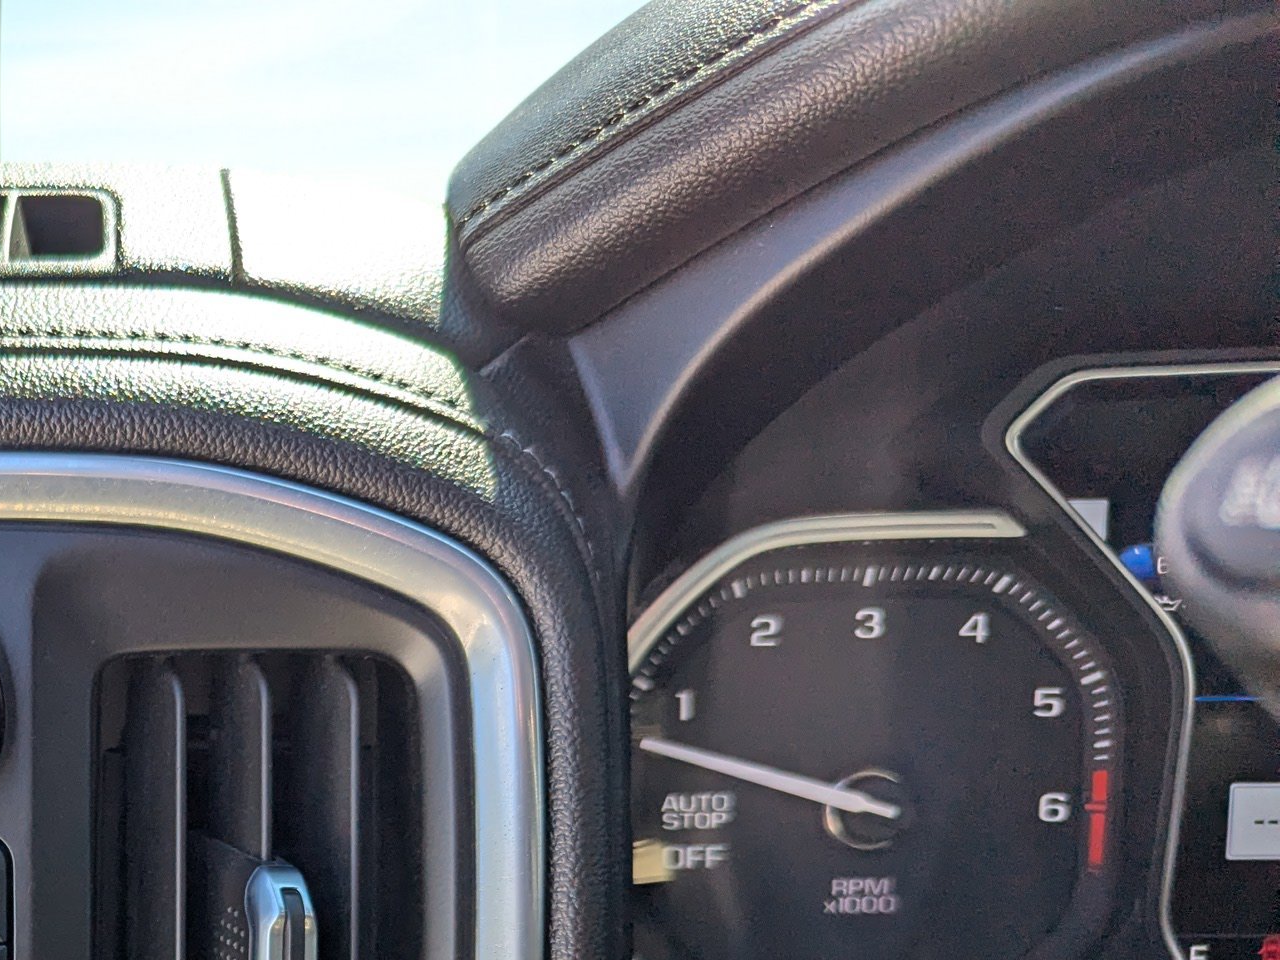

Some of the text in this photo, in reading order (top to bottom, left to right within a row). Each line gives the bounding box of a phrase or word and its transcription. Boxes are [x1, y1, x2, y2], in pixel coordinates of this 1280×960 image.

[749, 614, 784, 648] 2
[853, 606, 887, 640] 3
[958, 612, 991, 644] 4
[674, 689, 696, 722] 1
[1033, 687, 1065, 718] 5
[661, 792, 735, 813] AUTO
[1038, 792, 1071, 823] 6
[662, 811, 730, 831] STOP
[663, 844, 728, 871] OFF
[831, 878, 892, 896] RPM
[823, 895, 897, 914] x1000
